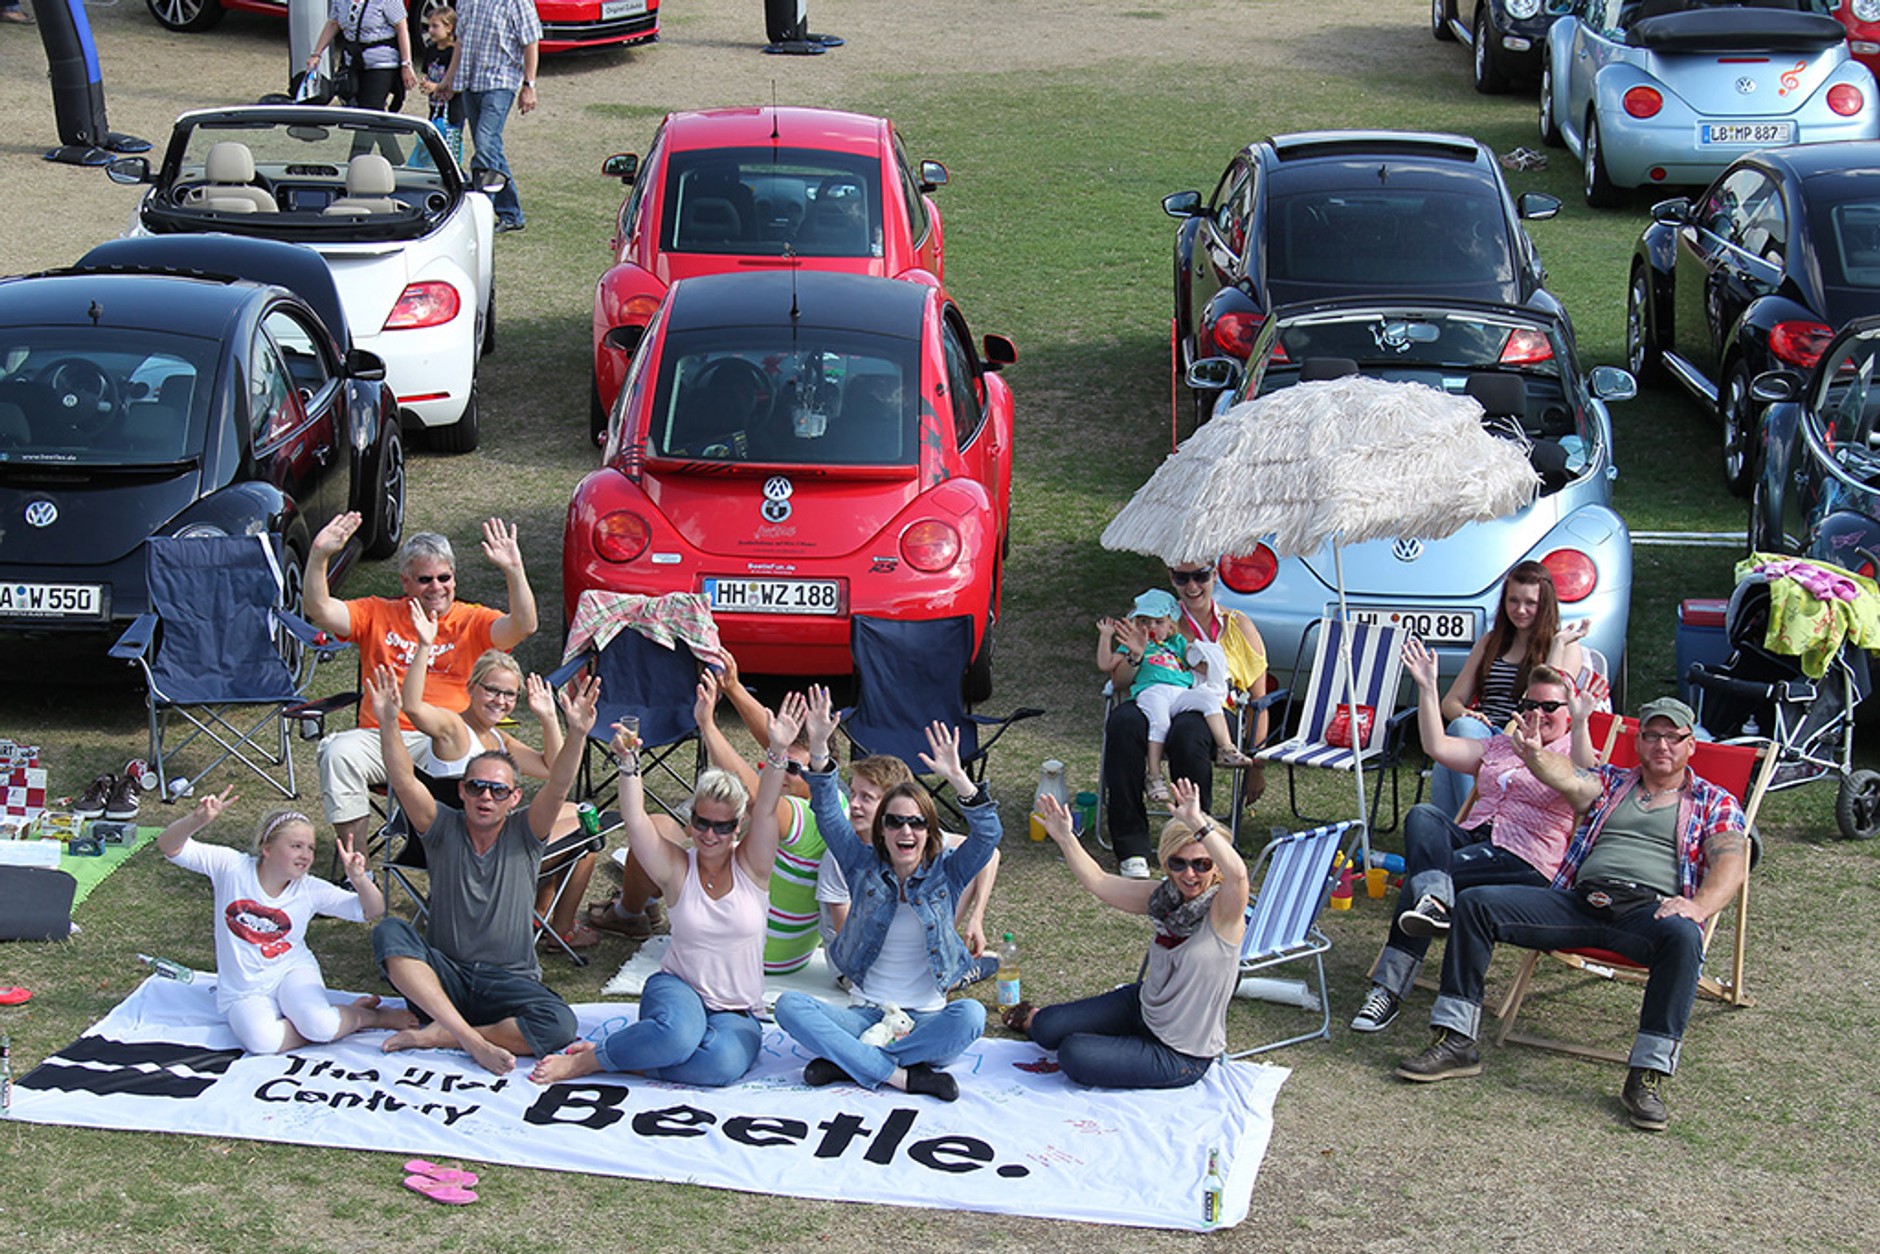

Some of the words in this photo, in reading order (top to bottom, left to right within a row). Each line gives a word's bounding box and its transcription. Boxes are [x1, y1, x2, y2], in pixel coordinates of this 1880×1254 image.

[1711, 126, 1728, 141] LB
[1735, 126, 1752, 140] MP
[1755, 126, 1778, 140] 887
[0, 587, 13, 608] A
[29, 588, 44, 608] W
[49, 588, 91, 610] 550
[717, 583, 746, 604] HH
[761, 584, 789, 605] WZ
[794, 585, 835, 607] 188
[1437, 615, 1464, 637] 88
[523, 1083, 1031, 1178] Beetle.
